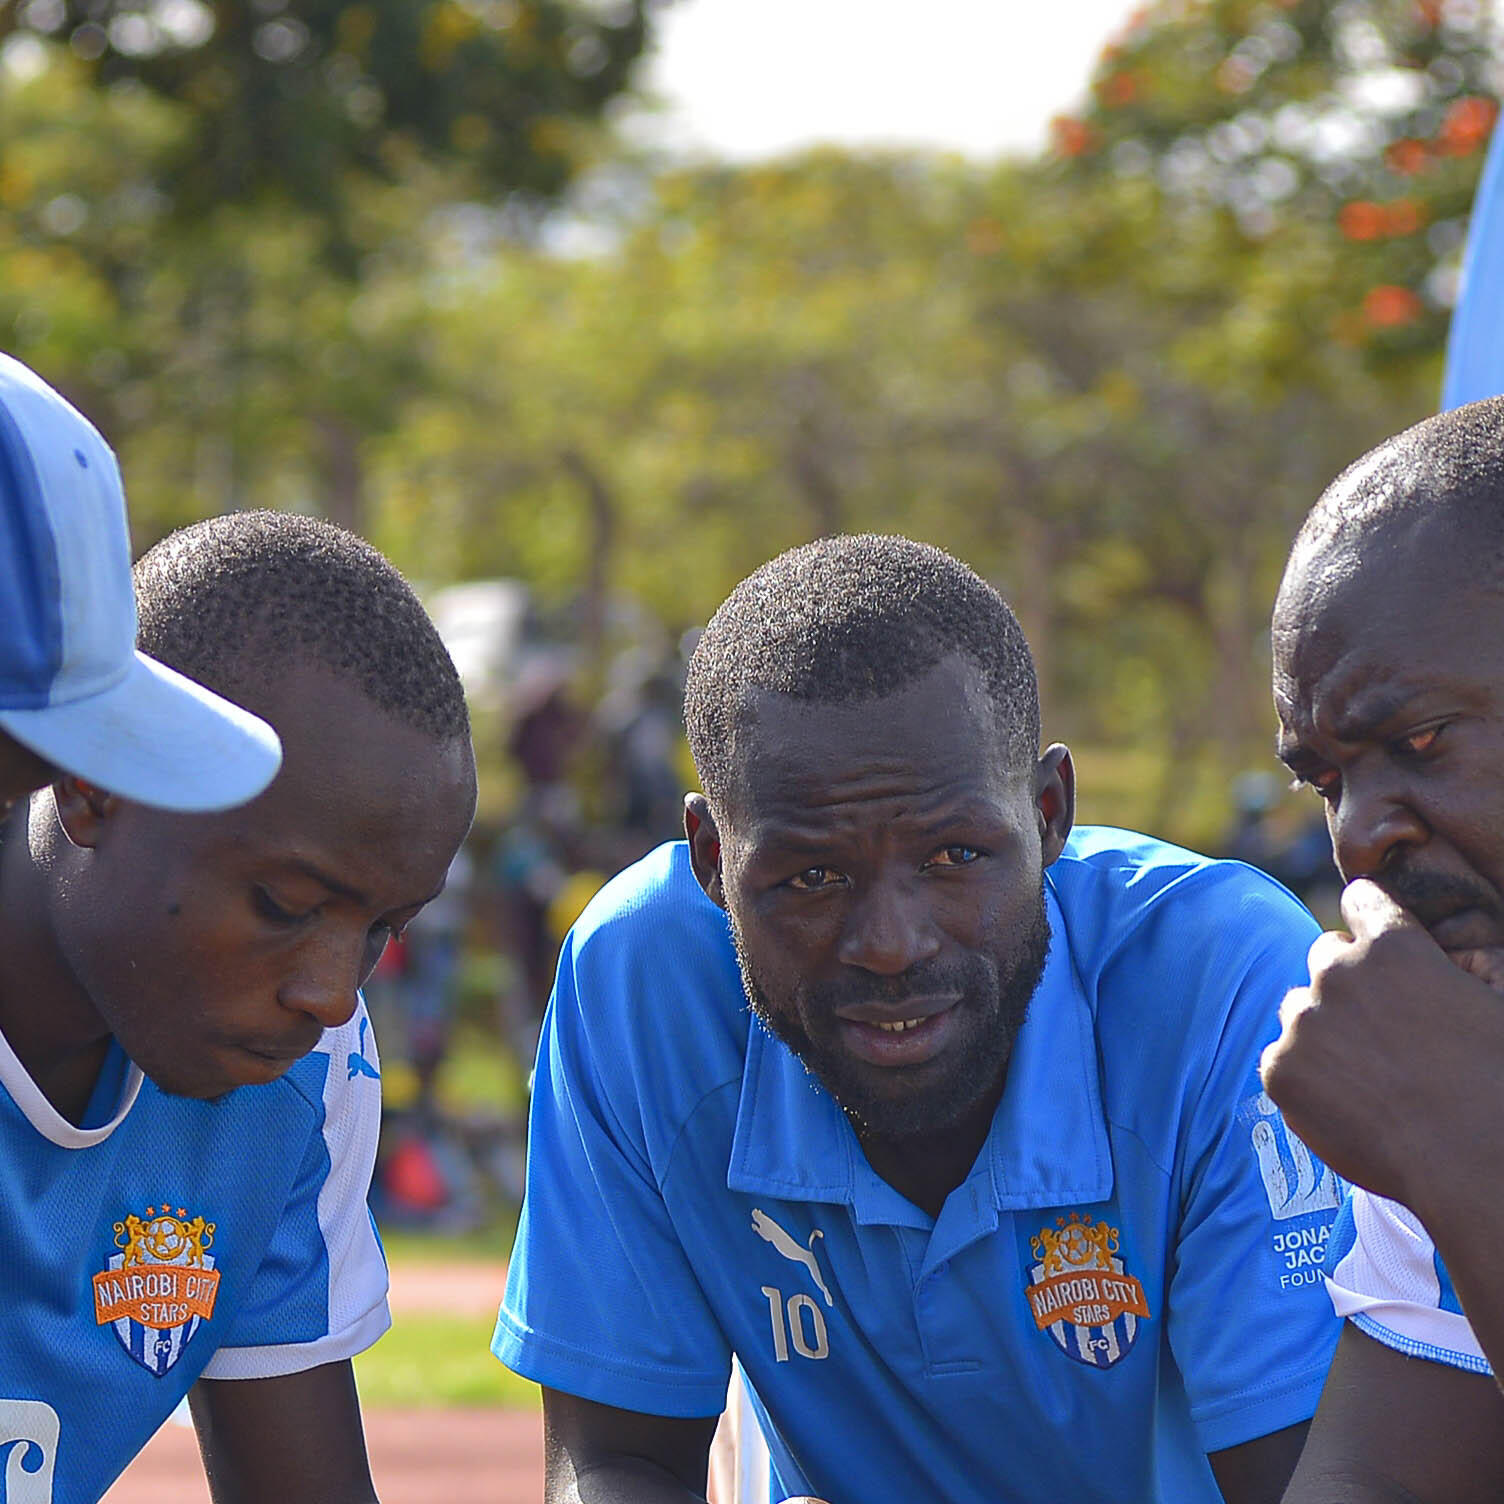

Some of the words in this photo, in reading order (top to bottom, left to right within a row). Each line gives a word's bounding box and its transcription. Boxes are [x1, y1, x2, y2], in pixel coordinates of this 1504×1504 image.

[1273, 1224, 1334, 1251] JONA
[1284, 1244, 1327, 1270] JAC
[97, 1273, 177, 1308] NAIROBI
[185, 1275, 216, 1304] CITY
[1033, 1278, 1100, 1318] NAIROBI
[1101, 1278, 1139, 1305] CITY
[139, 1302, 189, 1323] STARS
[761, 1286, 829, 1362] 10
[1073, 1303, 1111, 1324] STARS
[155, 1340, 171, 1354] FC
[1088, 1338, 1109, 1352] FC
